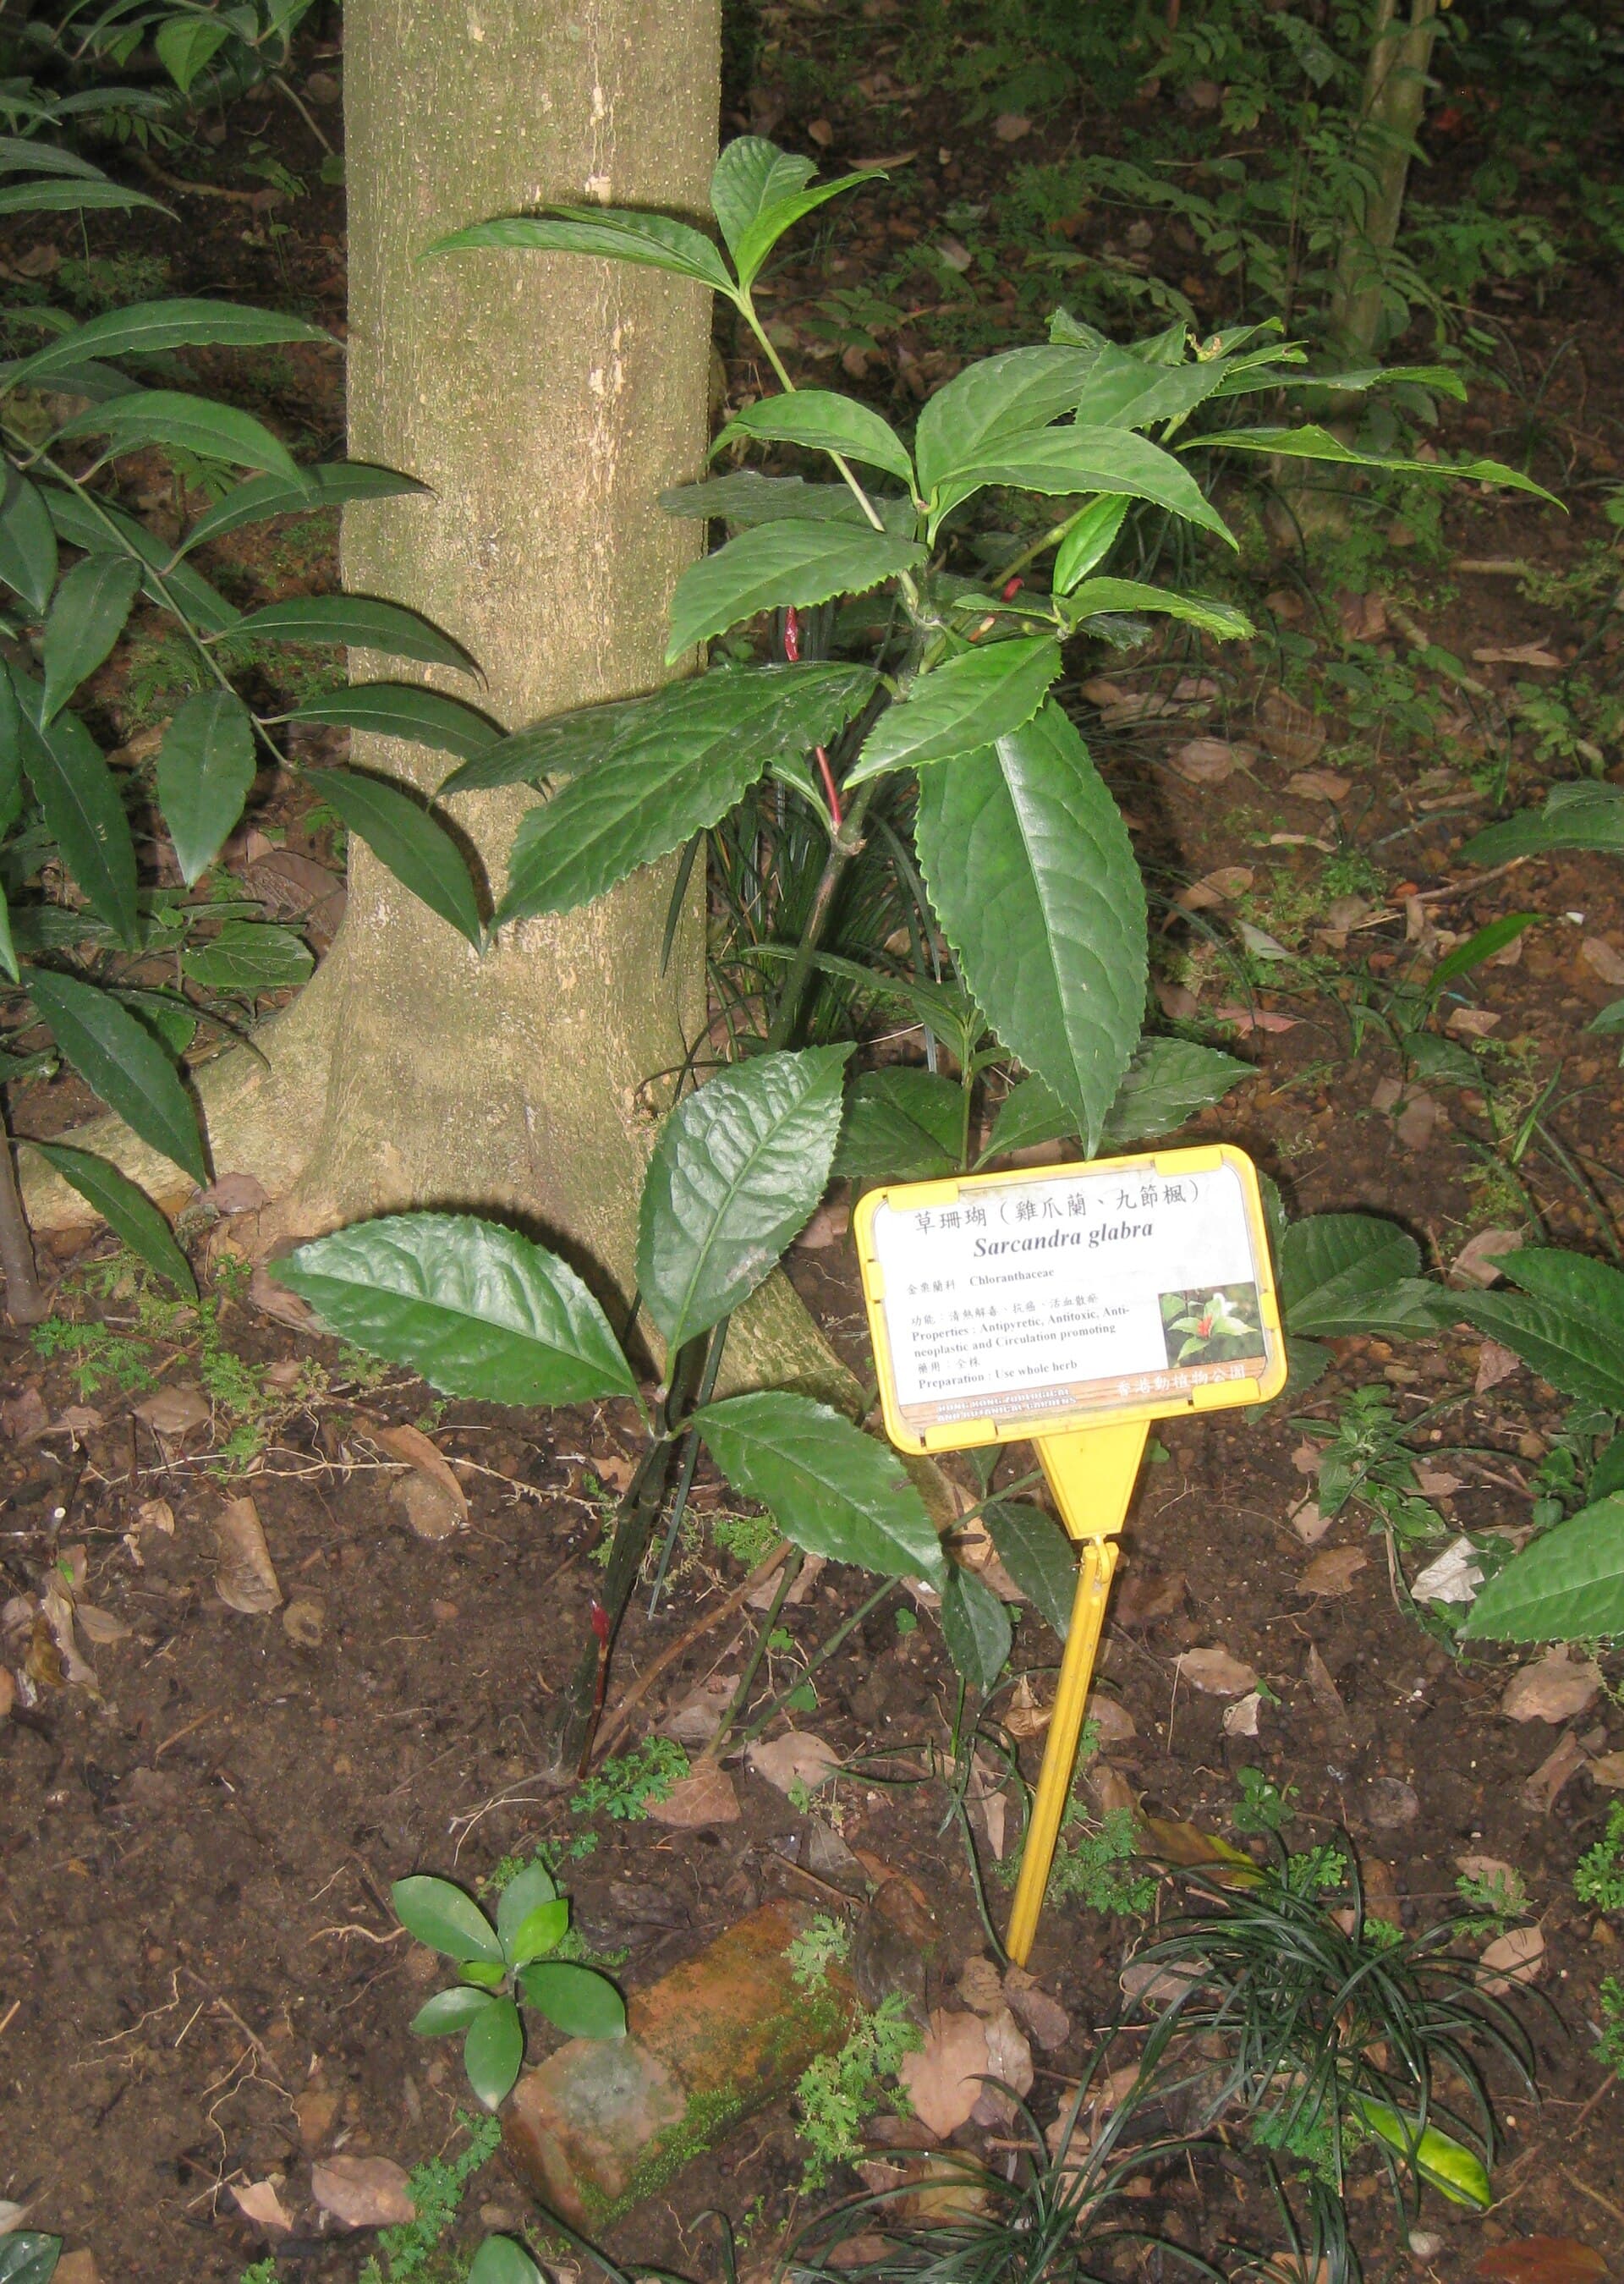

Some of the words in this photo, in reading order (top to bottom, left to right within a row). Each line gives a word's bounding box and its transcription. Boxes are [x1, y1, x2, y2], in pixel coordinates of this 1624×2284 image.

[974, 1229, 1081, 1257] Sarcandra
[1089, 1221, 1153, 1249] glabra
[969, 1269, 1055, 1286] Chloranthaceae
[912, 1326, 968, 1342] Properties
[981, 1317, 1044, 1333] Antipyretic,
[1049, 1309, 1099, 1325] Antitoxic,
[1103, 1304, 1129, 1317] Anti-
[914, 1342, 968, 1358] neoplastic
[973, 1338, 992, 1350] and
[996, 1331, 1056, 1347] Circulation
[1061, 1324, 1116, 1341] promoting
[919, 1374, 984, 1389] Preparation
[996, 1368, 1014, 1379] Use
[1018, 1363, 1049, 1375] whole
[1053, 1360, 1078, 1371] herb
